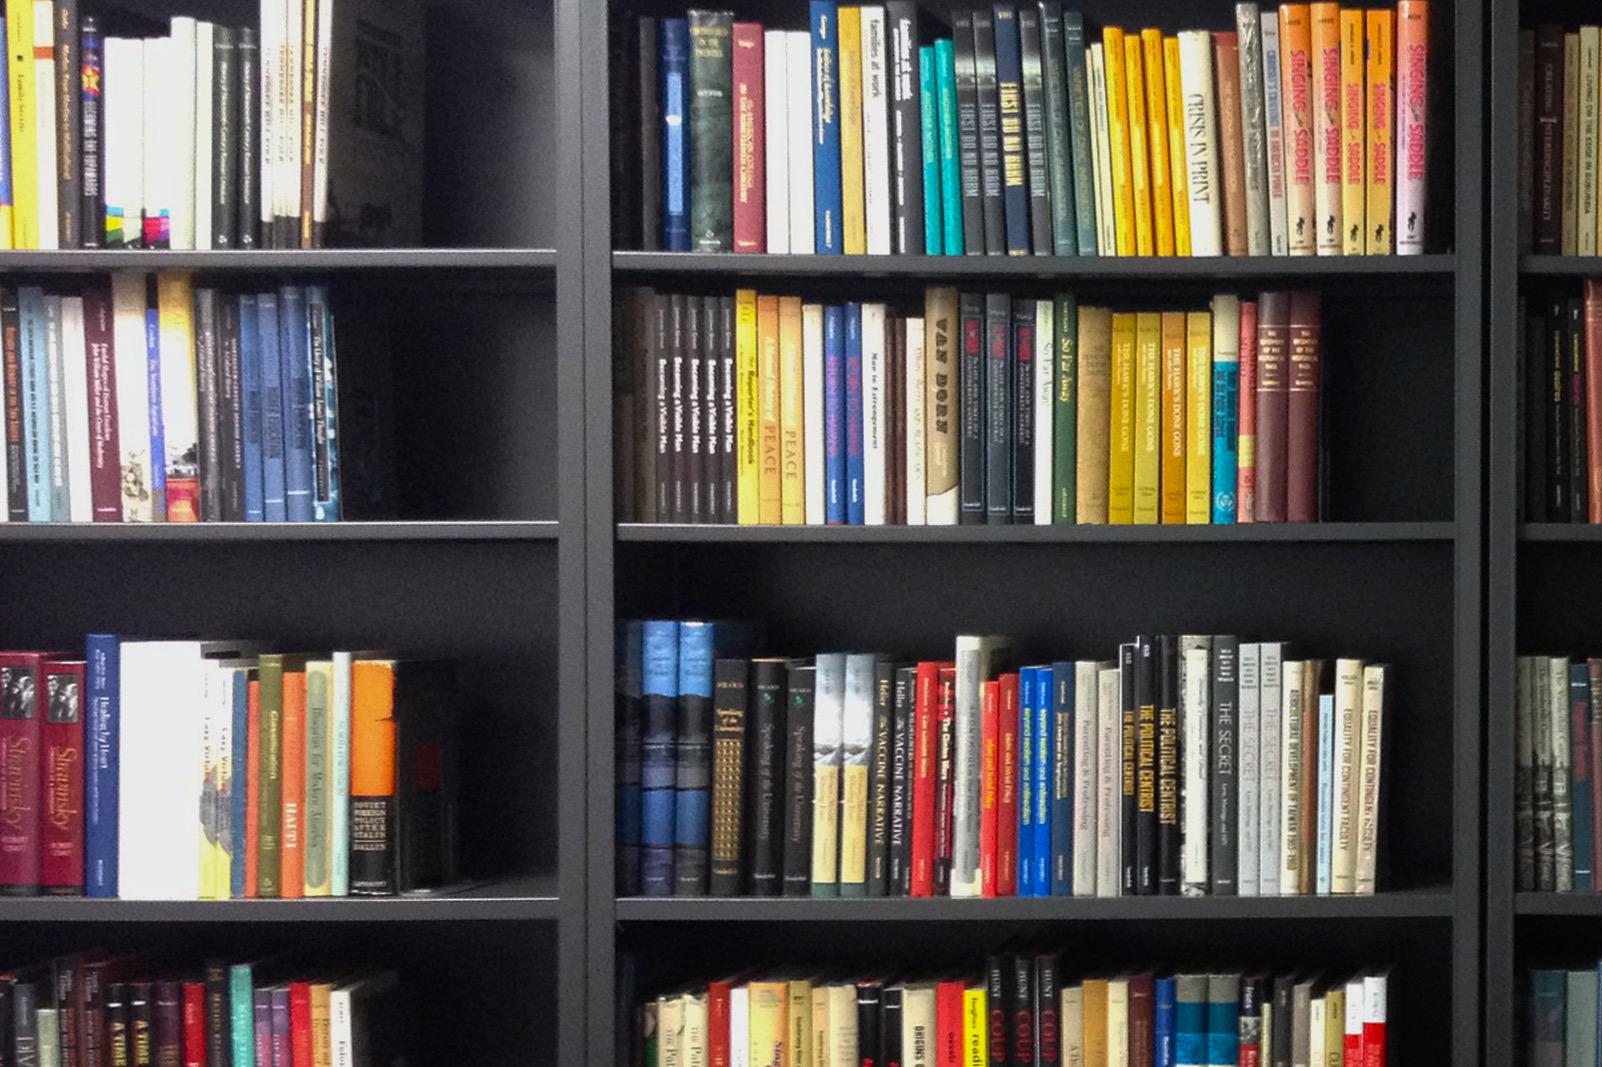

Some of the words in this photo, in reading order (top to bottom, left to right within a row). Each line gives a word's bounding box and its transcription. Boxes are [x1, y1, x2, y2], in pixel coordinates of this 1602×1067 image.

[871, 19, 880, 58] families
[900, 19, 911, 60] families
[871, 61, 880, 71] at
[901, 62, 911, 72] at
[1291, 50, 1307, 112] SINGING
[1409, 45, 1425, 107] SINGING
[872, 74, 881, 98] work
[902, 74, 912, 101] work
[1000, 82, 1018, 113] FIRST
[1187, 94, 1207, 138] CRISIS
[1373, 83, 1385, 129] SINGING
[85, 139, 97, 152] THE
[1190, 142, 1207, 158] IN
[1294, 129, 1308, 184] SADDLE
[1374, 142, 1386, 184] SADDLE
[1408, 124, 1424, 180] SADDLE
[1584, 137, 1592, 158] EDGE
[1191, 161, 1209, 204] PRINT
[937, 318, 947, 364] VAN
[1061, 337, 1072, 353] So
[1171, 347, 1181, 365] THE
[707, 359, 716, 399] Becoming
[1062, 355, 1072, 372] Far
[936, 373, 948, 434] DORN
[1060, 375, 1072, 403] Away
[708, 407, 717, 433] Visible
[1172, 404, 1181, 431] DONE
[708, 436, 717, 454] Man
[747, 420, 755, 465] Handbook
[764, 425, 776, 475] PEACE
[785, 430, 797, 480] PEACE
[1173, 433, 1182, 457] GONE
[896, 681, 905, 708] Heller
[1161, 708, 1176, 726] THE
[1218, 702, 1231, 725] THE
[1340, 708, 1353, 746] EQUALITY
[98, 732, 109, 742] by
[762, 723, 774, 766] Speaking
[1161, 728, 1176, 776] POLITICAL
[1218, 730, 1231, 775] SECRET
[762, 769, 773, 777] of
[894, 732, 905, 780] VACCINE
[1340, 749, 1351, 765] FOR
[8, 736, 31, 831] Stravinsky
[55, 746, 77, 831] Stravinsky
[763, 780, 772, 791] the
[1340, 767, 1352, 813] CONTINGENT
[893, 785, 903, 846] NARRATIVE
[1161, 779, 1176, 825] CENTRIST
[286, 802, 297, 848] HAITI
[1340, 816, 1352, 851] FACULTY
[1018, 971, 1027, 999] HUNT
[1043, 969, 1053, 999] HUNT
[137, 1021, 148, 1029] A
[1017, 1010, 1031, 1063] COUP
[1041, 1008, 1056, 1062] COUP
[137, 1034, 148, 1064] TIME
[915, 1026, 925, 1061] ORIGINS
